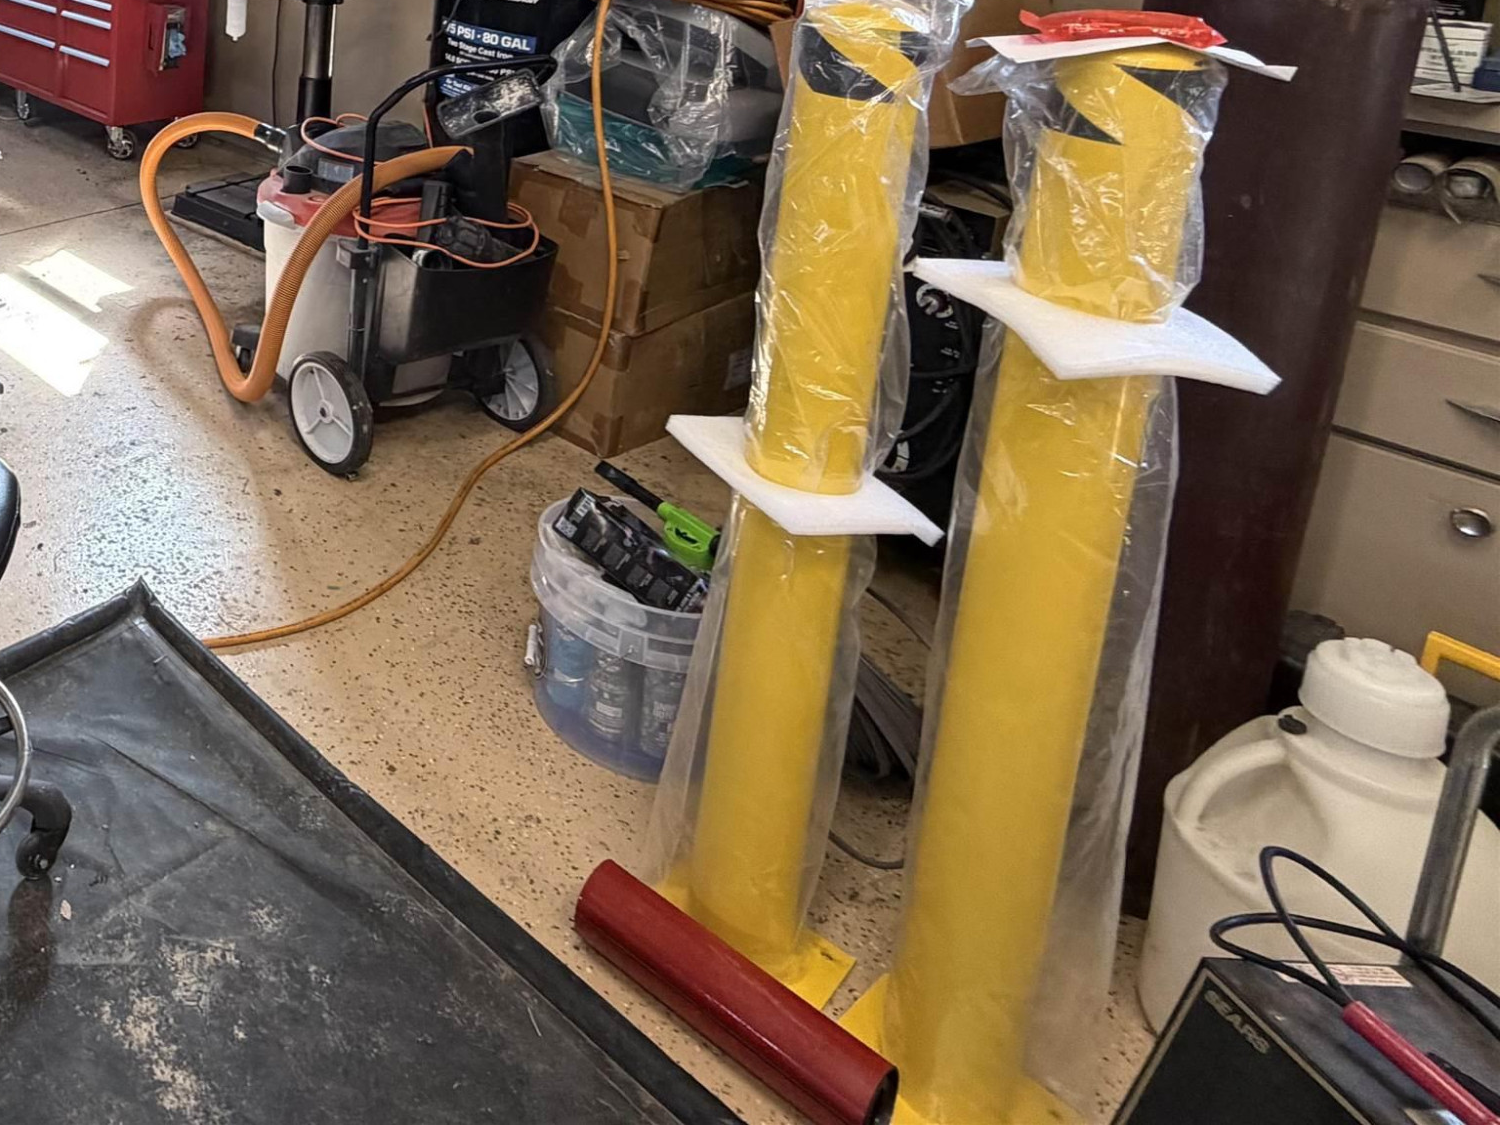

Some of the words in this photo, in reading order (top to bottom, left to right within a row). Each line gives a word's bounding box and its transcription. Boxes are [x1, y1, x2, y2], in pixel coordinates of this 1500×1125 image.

[457, 26, 476, 40] PSI
[482, 32, 499, 45] 80
[501, 36, 531, 51] GAL
[1204, 990, 1270, 1055] SEARS
